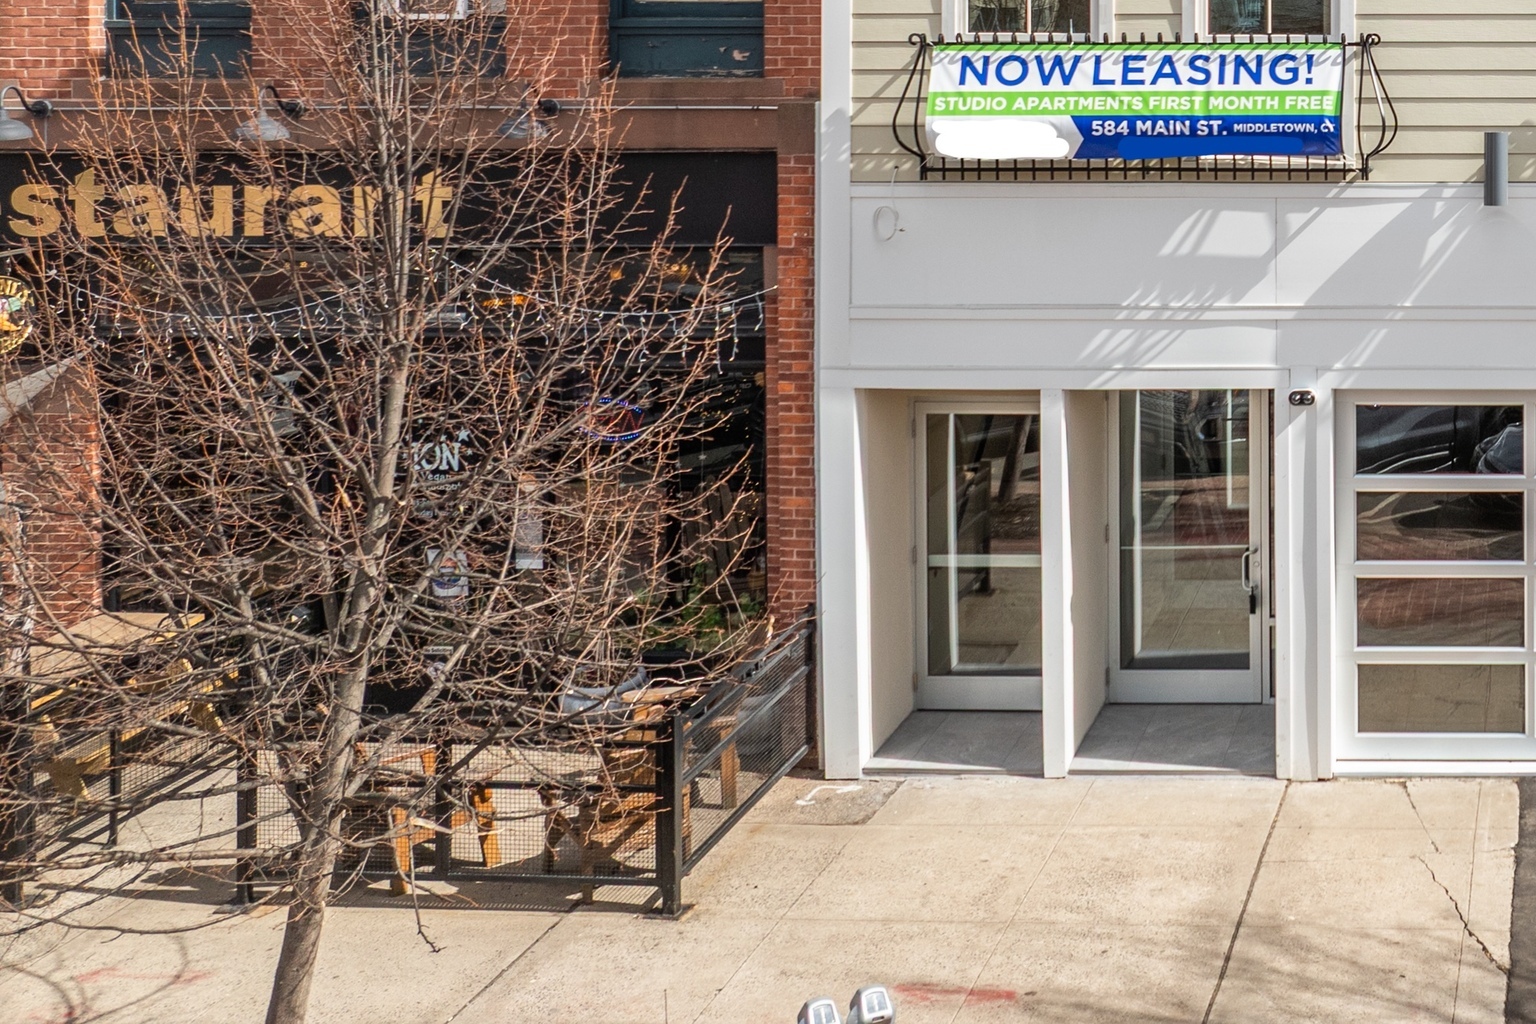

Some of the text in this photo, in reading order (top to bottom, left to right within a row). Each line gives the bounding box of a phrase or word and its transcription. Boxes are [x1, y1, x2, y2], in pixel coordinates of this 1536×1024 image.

[958, 54, 1315, 86] NOW LEASING!
[934, 95, 1334, 111] STUDIO APARTMENTS FIRST MONTH FREE
[1091, 119, 1335, 136] 584 MAIN ST. MIDDLETOWN, CT
[0, 166, 453, 238] staurant
